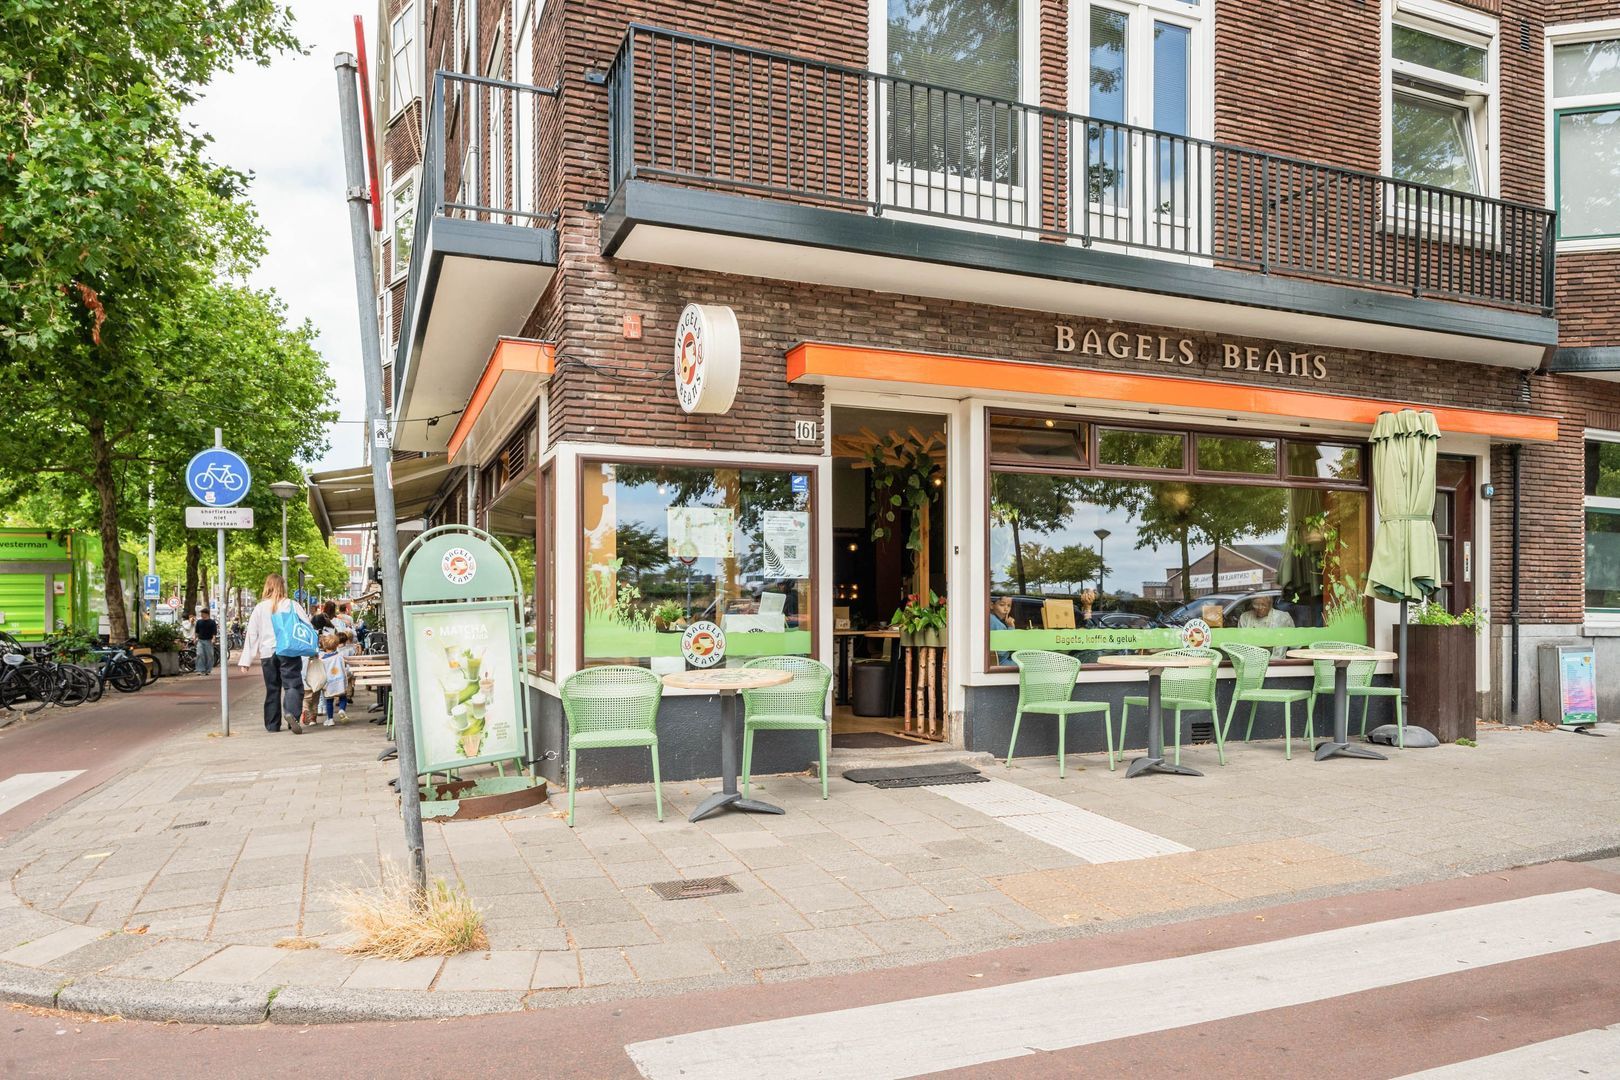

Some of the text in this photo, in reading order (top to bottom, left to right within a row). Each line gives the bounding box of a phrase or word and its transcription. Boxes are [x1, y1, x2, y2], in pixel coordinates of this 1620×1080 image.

[677, 311, 702, 349] BAGELS
[1054, 325, 1194, 365] BAGELS
[1222, 343, 1327, 379] BEANS
[679, 373, 702, 405] BEANS
[797, 422, 815, 439] 161
[445, 550, 472, 562] BAGELS
[147, 577, 157, 587] P
[447, 572, 473, 583] BEANS
[439, 624, 489, 637] MATCHA
[686, 623, 722, 639] BAGELS
[1184, 621, 1210, 634] BAGELS
[1055, 635, 1137, 646] Bagels, koffie & geluk
[687, 652, 721, 665] BEANS
